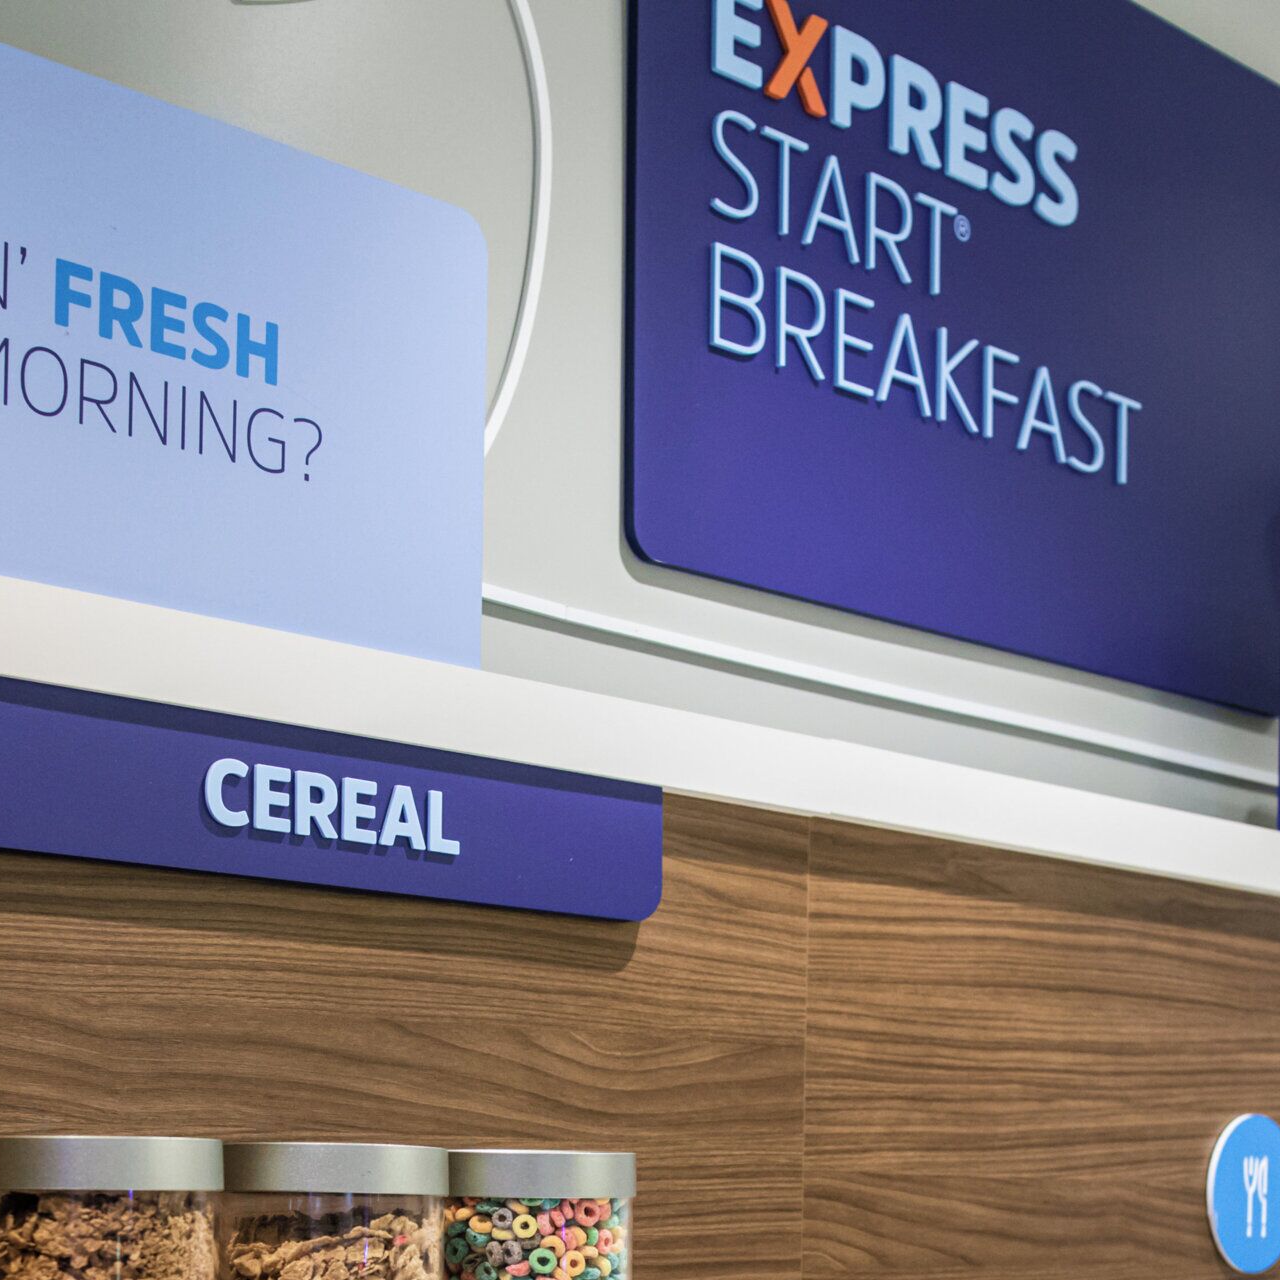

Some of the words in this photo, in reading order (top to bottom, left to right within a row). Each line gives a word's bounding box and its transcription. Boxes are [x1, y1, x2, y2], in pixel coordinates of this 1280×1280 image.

[710, 0, 1079, 227] EXPRESS
[53, 257, 280, 387] FRESH
[709, 241, 1142, 485] BREAKFAST
[204, 757, 462, 857] CEREAL
